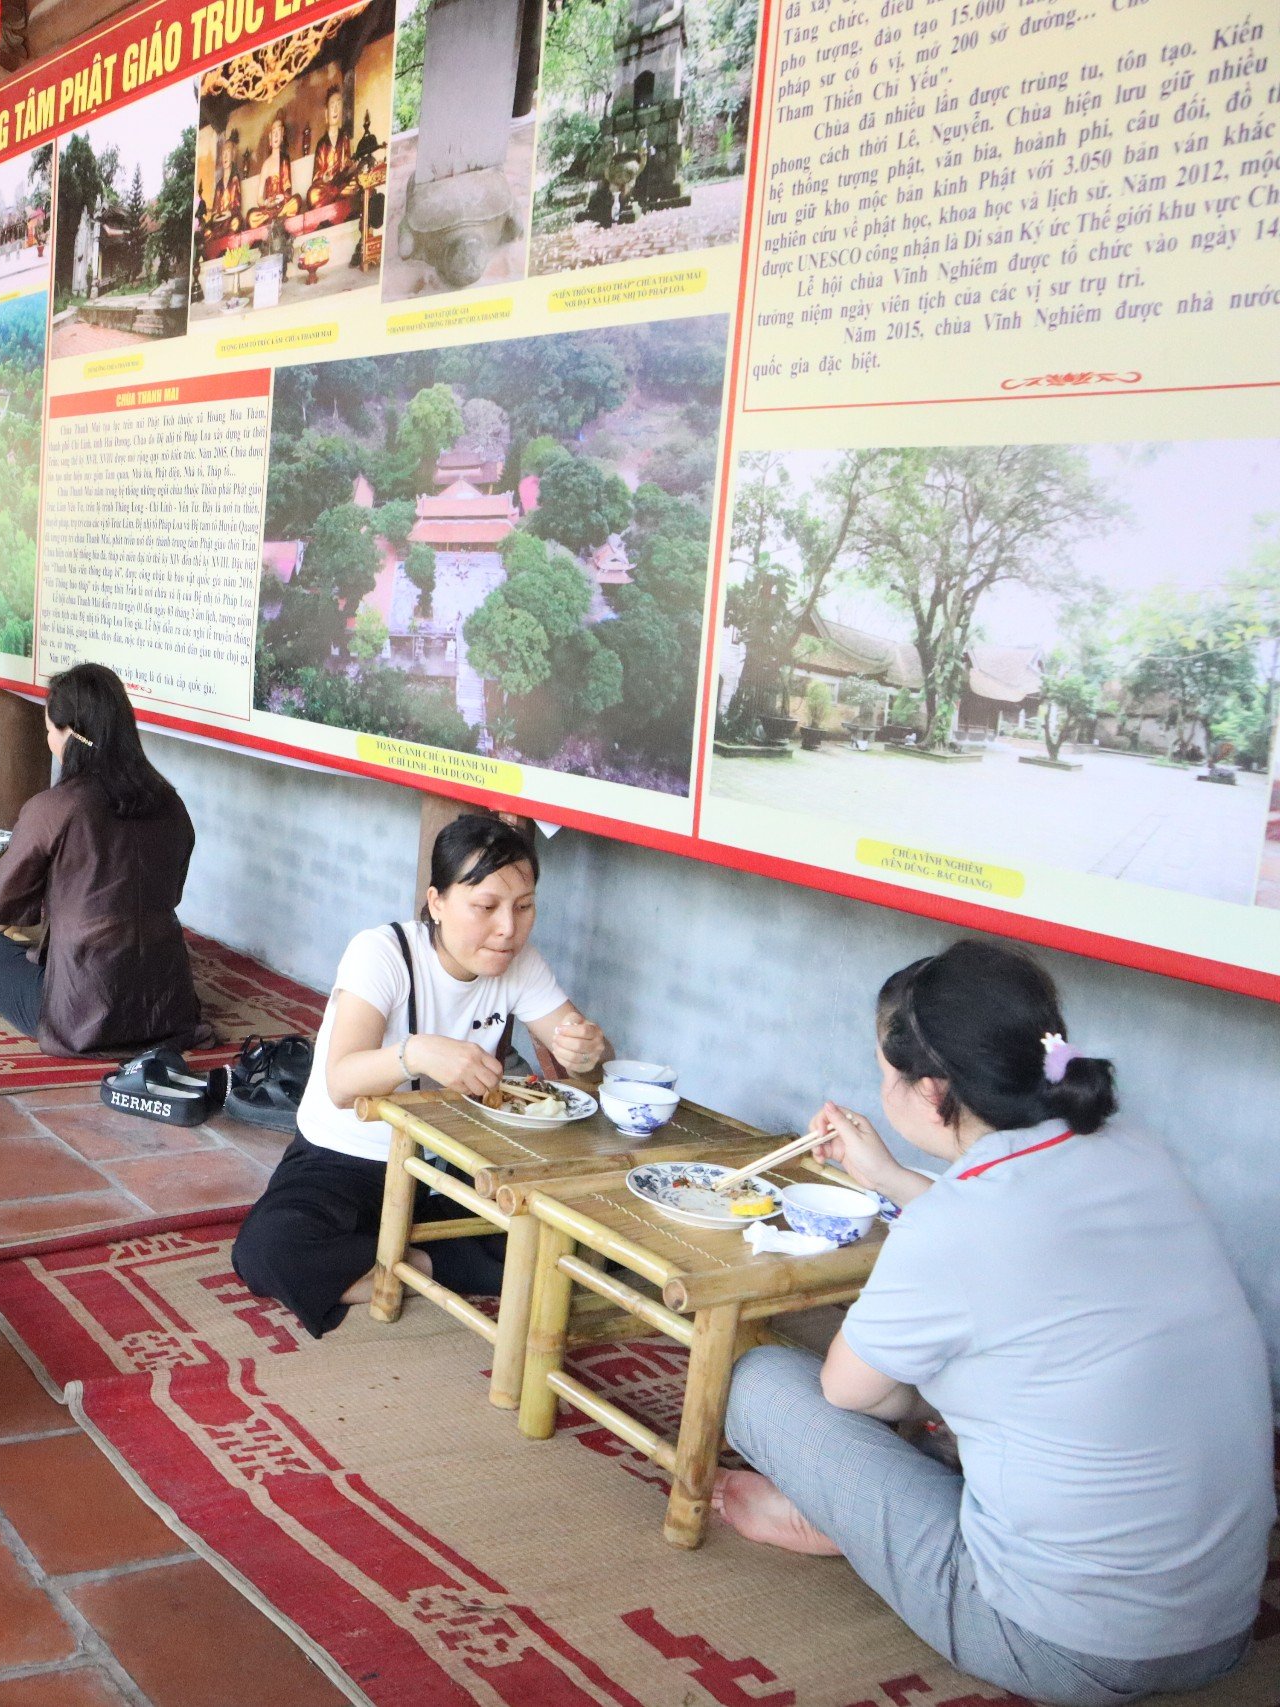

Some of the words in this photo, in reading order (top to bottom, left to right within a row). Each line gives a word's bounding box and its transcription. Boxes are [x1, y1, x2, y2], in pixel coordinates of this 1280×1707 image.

[14, 86, 56, 143] TÂM
[58, 52, 118, 123] PHẬT
[121, 20, 183, 93] GIÁO
[778, 79, 811, 103] pháp
[870, 56, 878, 75] 6
[951, 30, 978, 55] 200
[814, 118, 850, 141] Chùa
[885, 96, 925, 126] nhiều
[935, 88, 958, 115] lần
[969, 84, 1010, 108] được
[1021, 71, 1069, 95] trùng
[1117, 49, 1147, 73] tôn
[1161, 41, 1197, 66] tạo.
[1212, 13, 1264, 51] Kiến
[771, 155, 811, 180] phong
[819, 145, 849, 166] cách
[859, 136, 888, 158] thời
[1006, 102, 1051, 128] Chùa
[1064, 90, 1102, 117] hiện
[1115, 84, 1146, 105] lưu
[1160, 69, 1195, 101] giữ
[1208, 47, 1268, 84] nhiều
[792, 171, 829, 195] thống
[838, 165, 878, 192] tượng
[936, 150, 962, 169] văn
[1014, 128, 1066, 156] hoành
[1126, 109, 1160, 134] câu
[1225, 81, 1252, 114] đồ
[767, 210, 787, 226] lưu
[795, 203, 816, 226] giữ
[858, 191, 887, 212] mộc
[933, 175, 968, 198] kinh
[979, 166, 1017, 192] Phật
[1027, 159, 1054, 181] với
[1063, 147, 1112, 176] 3.050
[1174, 132, 1208, 154] ván
[1223, 111, 1276, 147] khắc
[762, 259, 793, 277] được
[798, 247, 862, 273] UNESCO
[865, 244, 899, 265] công
[903, 238, 940, 259] nhận
[1019, 220, 1044, 245] Ký
[1050, 218, 1071, 237] ức
[1076, 203, 1112, 234] Thế
[1115, 202, 1152, 234] giới
[1158, 199, 1196, 222] khu
[1204, 194, 1241, 219] vực
[764, 231, 806, 254] nghiên
[812, 225, 837, 244] cứu
[863, 217, 896, 242] phật
[939, 205, 976, 225] khoa
[983, 200, 1011, 222] học
[1047, 185, 1078, 212] lịch
[1120, 174, 1167, 197] Năm
[797, 274, 814, 298] Lễ
[822, 276, 842, 301] hội
[850, 270, 883, 291] chùa
[894, 264, 928, 286] Vĩnh
[937, 257, 998, 284] Nghiêm
[1008, 252, 1050, 274] được
[1089, 238, 1133, 262] chức
[1145, 233, 1178, 254] vào
[1191, 225, 1241, 253] ngày
[801, 304, 833, 327] niệm
[840, 299, 872, 322] ngày
[881, 297, 910, 314] viên
[918, 291, 945, 314] tịch
[1080, 275, 1107, 297] trụ
[843, 327, 876, 345] Năm
[934, 314, 971, 337] chùa
[984, 311, 1021, 331] Vĩnh
[1034, 303, 1102, 332] Nghiêm
[1115, 298, 1163, 323] được
[1176, 290, 1215, 315] nhà
[116, 391, 136, 407] CHÙA
[138, 389, 163, 404] THANH
[164, 386, 179, 400] MAI
[752, 355, 783, 382] quốc
[790, 357, 810, 379] gia
[818, 353, 842, 377] đặc
[851, 351, 881, 374] biệt.
[892, 847, 917, 861] CHÙA
[920, 852, 942, 866] VĨNH
[945, 859, 983, 875] NGHIÊM
